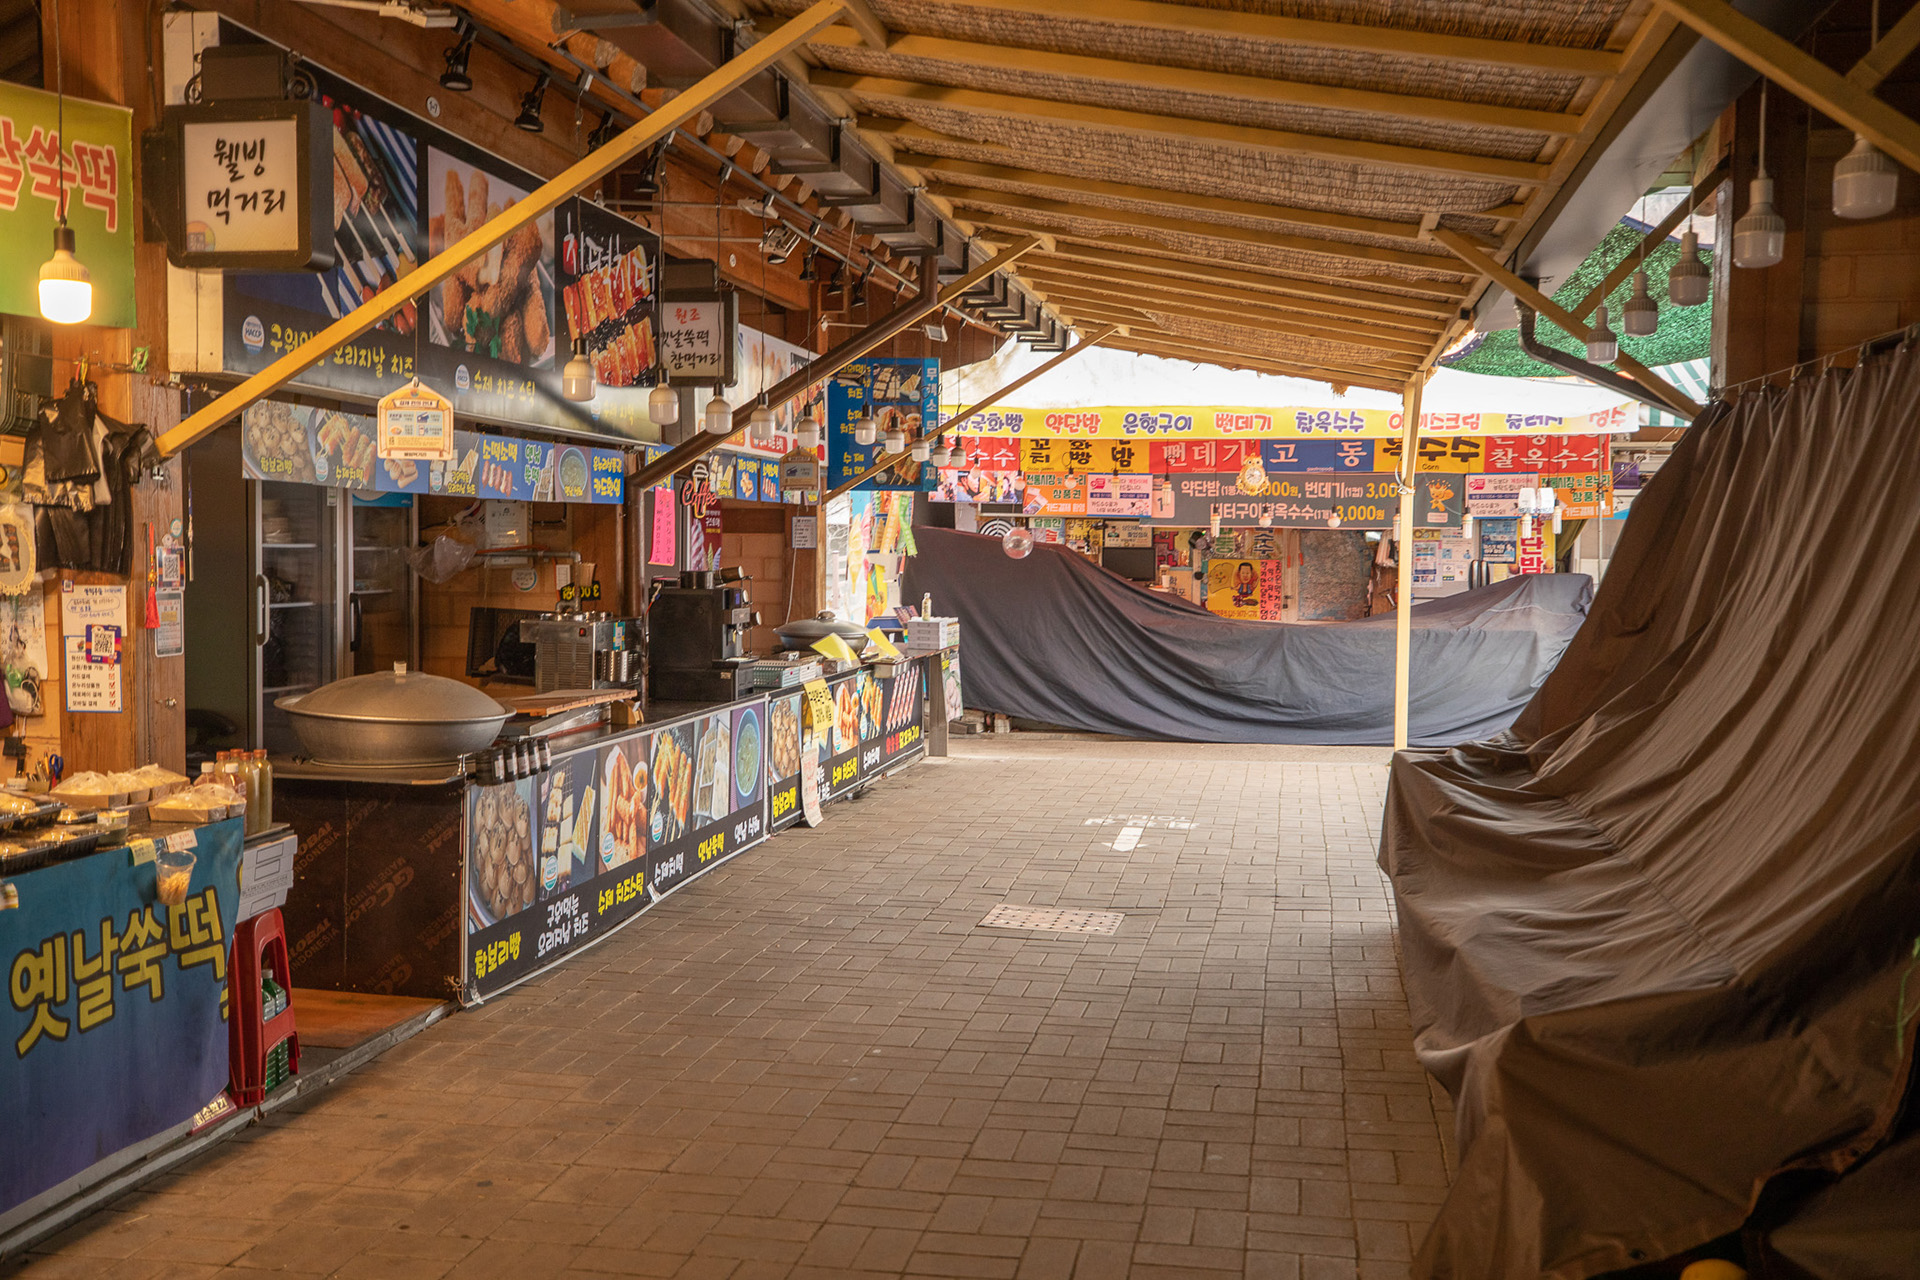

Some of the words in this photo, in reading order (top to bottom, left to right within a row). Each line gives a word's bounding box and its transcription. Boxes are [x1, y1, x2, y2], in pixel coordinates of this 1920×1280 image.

[213, 138, 266, 183] 웰빙
[207, 187, 286, 226] 먹거리
[674, 307, 701, 324] 원조
[333, 345, 386, 379] 오리지날
[390, 354, 414, 379] 치즈
[473, 369, 493, 393] 수제
[496, 379, 515, 399] 치즈
[519, 380, 536, 407] 스틱
[847, 388, 863, 399] 치즈
[926, 367, 938, 413] 무색소
[1045, 413, 1101, 434] 약단밤
[1123, 413, 1192, 434] 은행구이
[1215, 413, 1272, 433] 뻔데기
[1296, 411, 1364, 433] 찰옥수수
[260, 456, 293, 475] 찰보리빵
[482, 439, 518, 463] 소떡소떡
[525, 444, 542, 465] 옛날
[843, 452, 865, 464] 수제
[1489, 448, 1606, 470] 찰옥수수
[1422, 463, 1440, 471] Corn
[593, 477, 621, 497] 카드환영
[682, 480, 717, 505] Coffee
[1053, 489, 1081, 499] 상품권
[1336, 505, 1385, 521] 3,000원
[773, 786, 797, 818] 찰보리빵
[698, 831, 725, 863] 옛날쑥떡
[598, 889, 614, 916] 수제
[616, 871, 644, 905] 치즈스틱
[547, 893, 580, 929] 구워먹는
[538, 921, 572, 958] 오리지날
[574, 912, 589, 937] 치즈
[474, 931, 522, 979] 찰보리빵
[10, 887, 226, 1060] 옛날쑥떡
